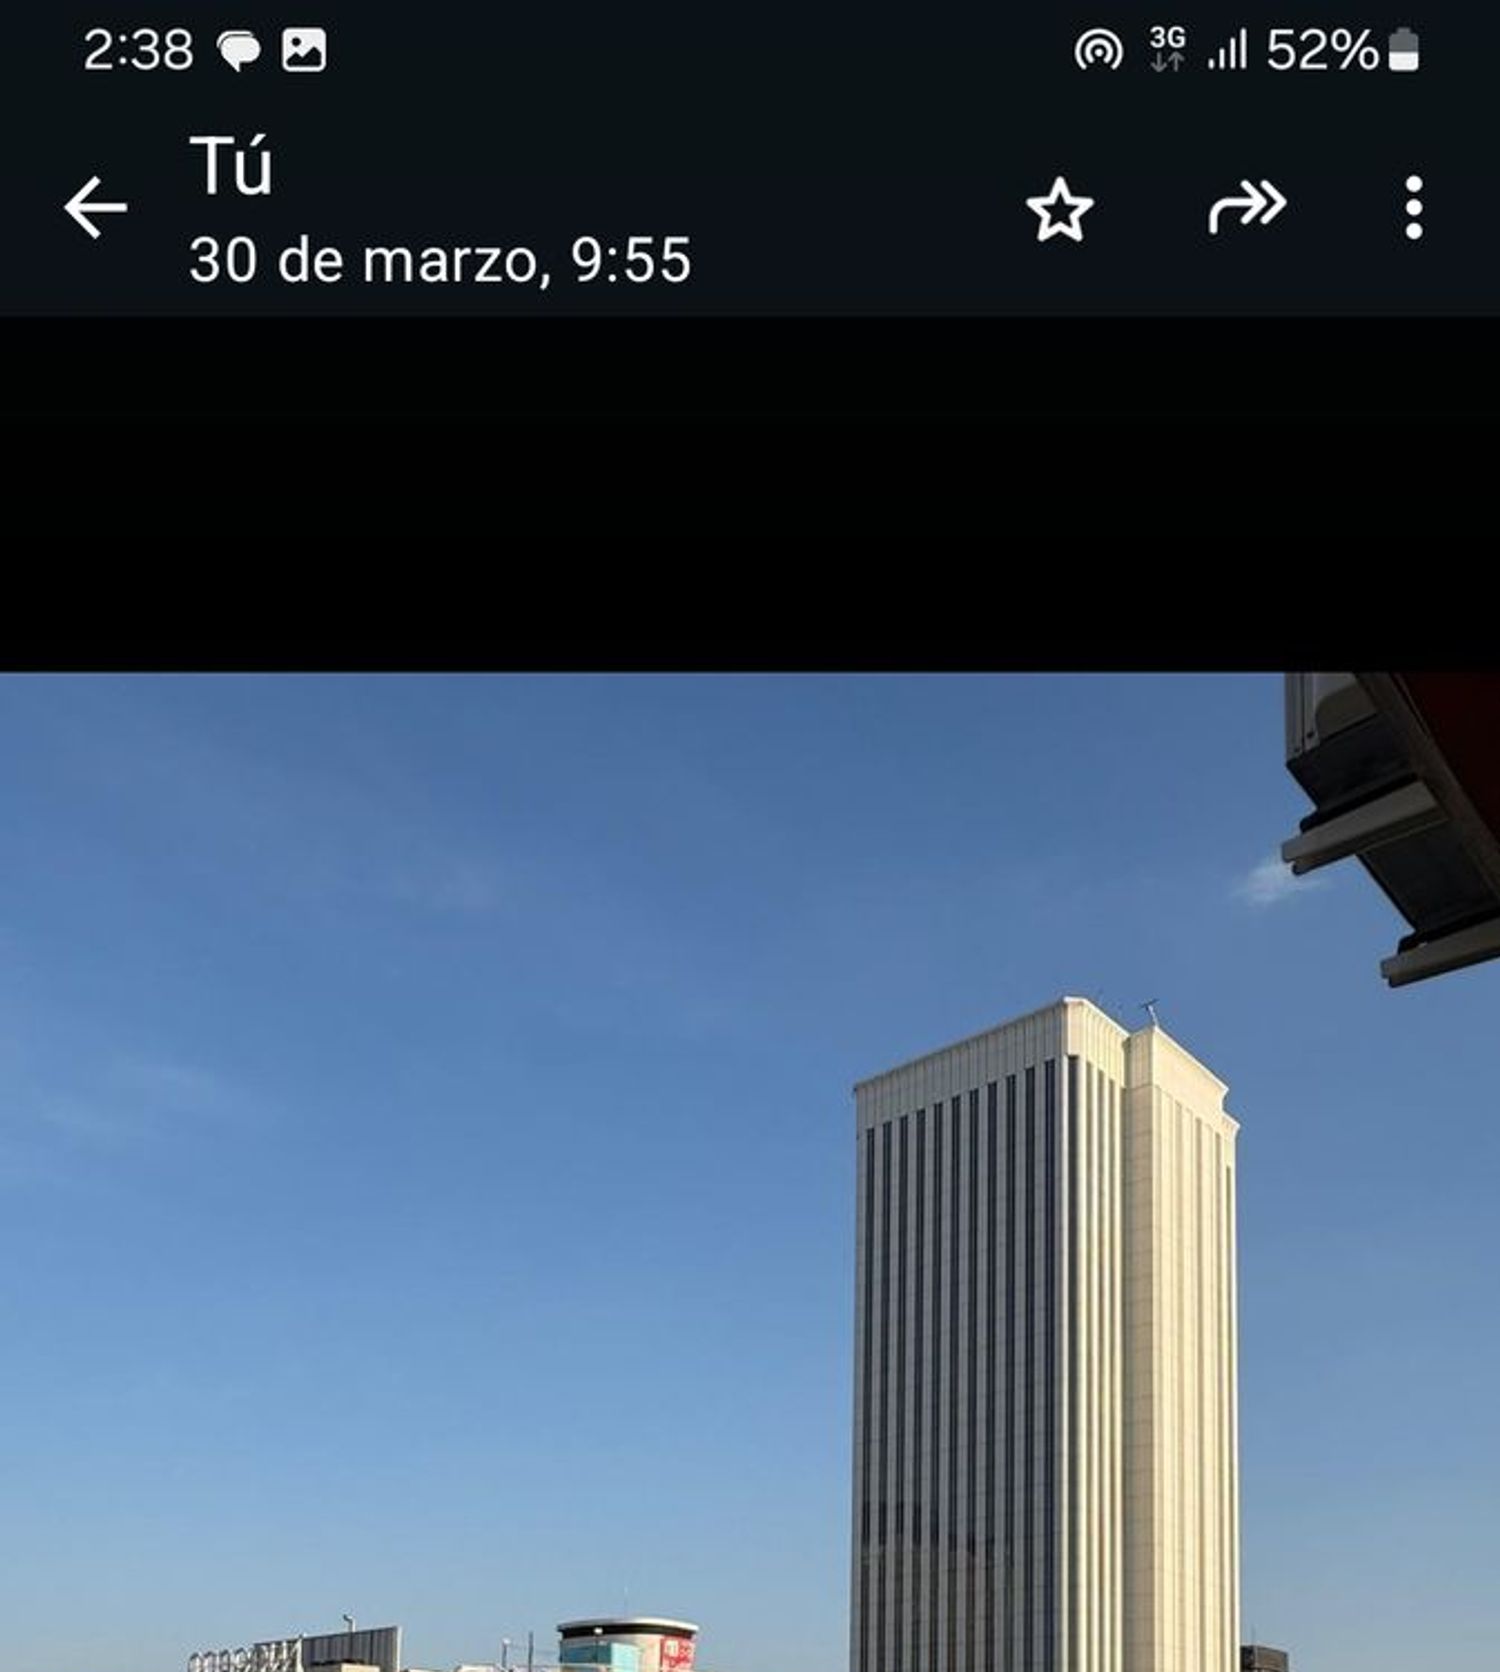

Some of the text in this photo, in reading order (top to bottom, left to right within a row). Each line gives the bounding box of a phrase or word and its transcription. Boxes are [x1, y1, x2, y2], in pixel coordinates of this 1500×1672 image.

[84, 28, 193, 70] 2:38
[1150, 26, 1186, 48] 3G
[1267, 28, 1380, 71] 52%
[189, 133, 271, 196] Tú
[190, 234, 691, 291] 30 de marzo, 9:55
